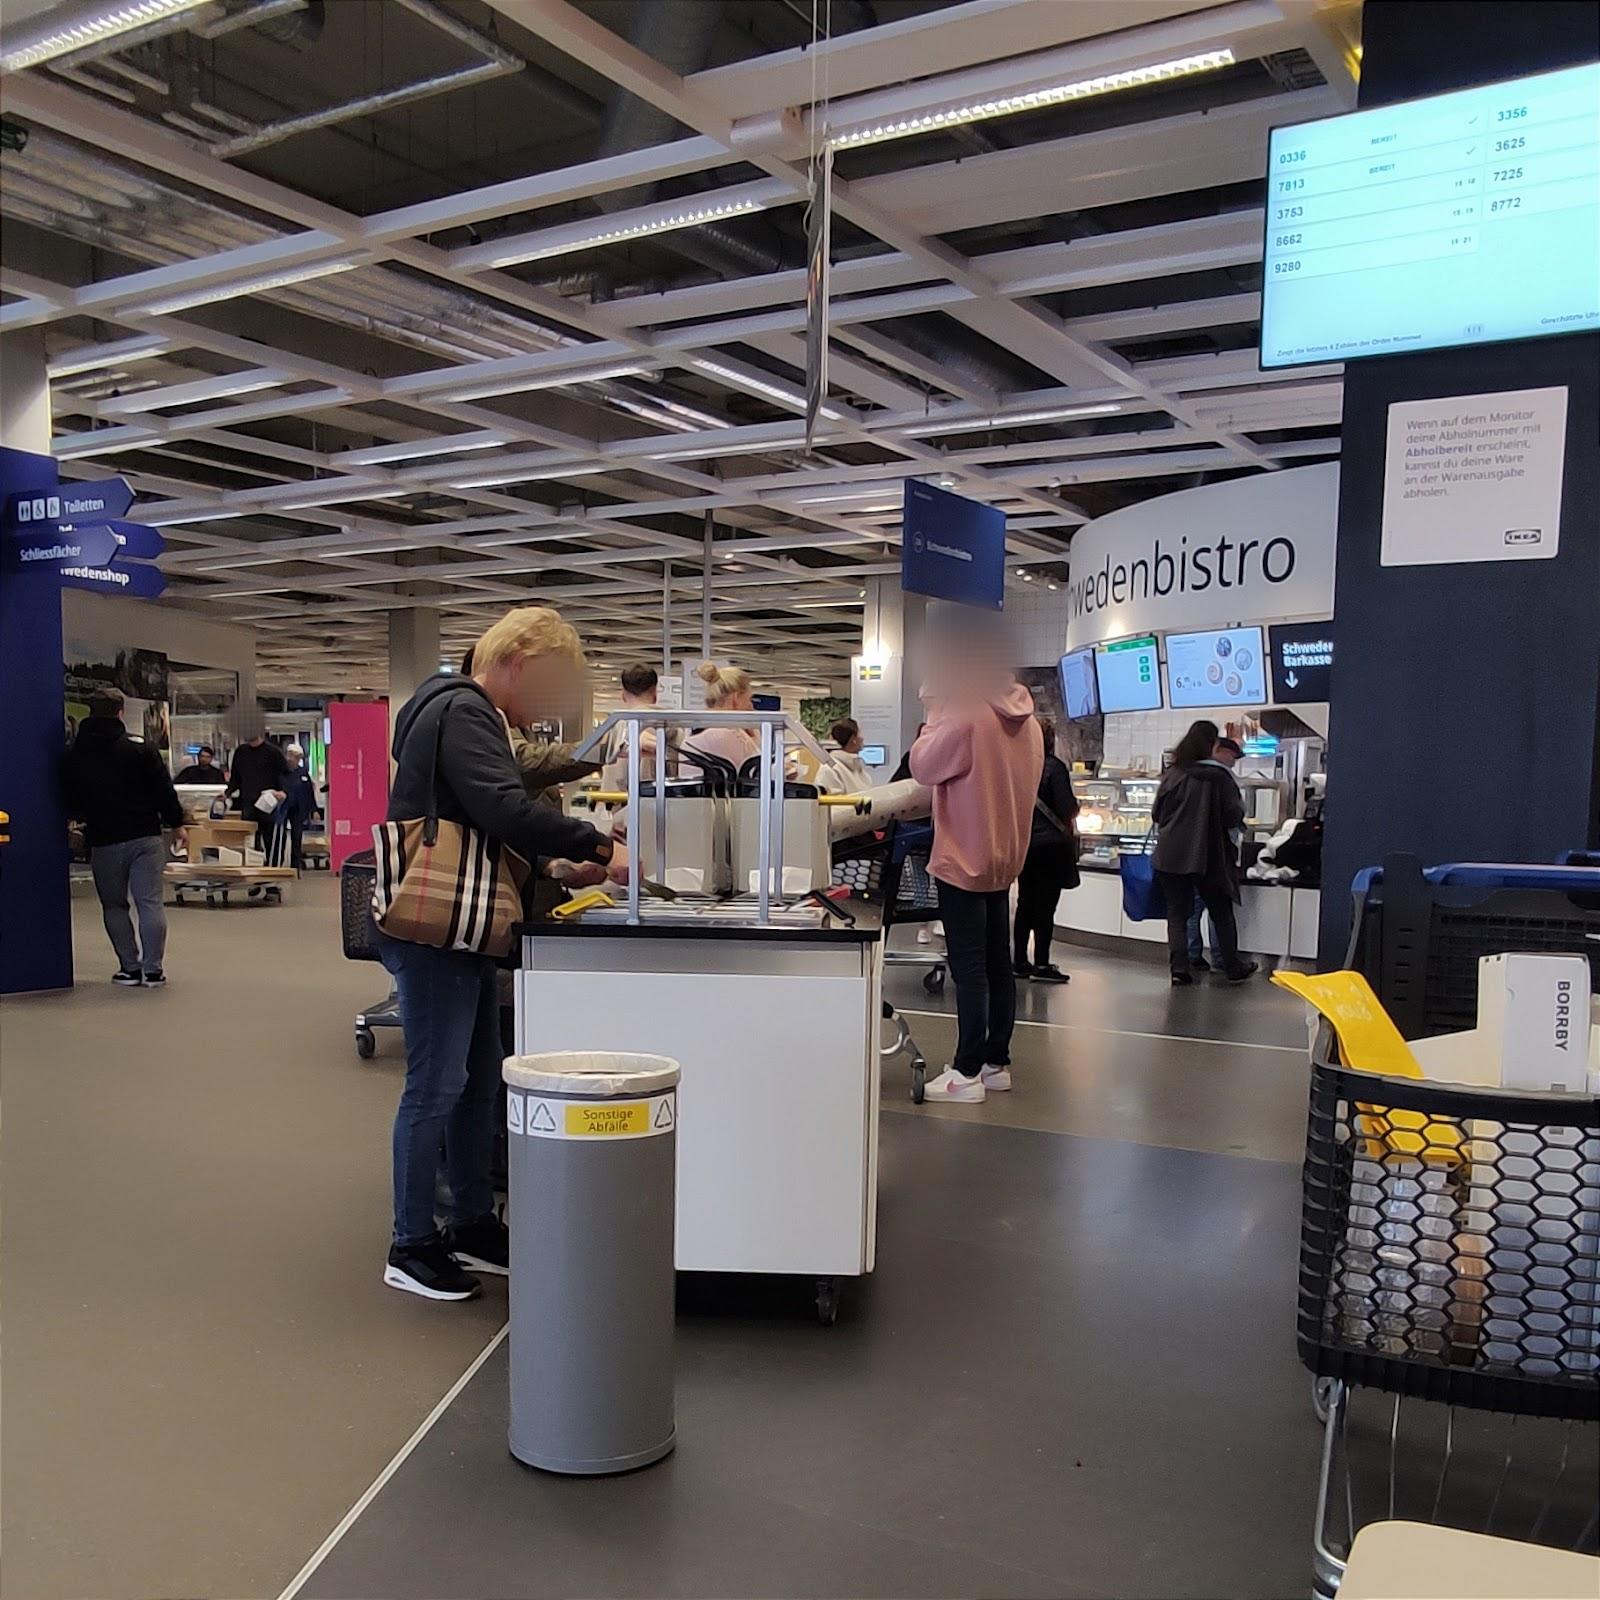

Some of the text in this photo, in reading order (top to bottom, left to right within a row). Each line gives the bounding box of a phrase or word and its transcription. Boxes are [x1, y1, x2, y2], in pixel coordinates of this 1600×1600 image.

[1497, 107, 1528, 122] 3356
[1495, 137, 1526, 152] 3625
[1280, 150, 1306, 164] 0336
[1493, 167, 1523, 182] 7225
[1278, 178, 1305, 192] 7813
[1491, 197, 1521, 212] 8772
[1277, 206, 1303, 220] 3753
[1276, 233, 1302, 247] 8662
[1274, 260, 1301, 274] 9280
[1407, 409, 1536, 431] Wenn auf dem Monitor
[1406, 424, 1541, 445] deine Abholnummer mit
[1405, 442, 1473, 457] Abholbereit
[1405, 453, 1525, 471] kannst du deine Ware
[1404, 467, 1525, 485] an der Warenausgabe
[63, 499, 105, 515] Toiletten
[20, 544, 82, 561] Schliessfächer
[1554, 980, 1571, 1051] BORRBY
[583, 1109, 634, 1121] Sonstige
[588, 1120, 629, 1132] Abfälle
